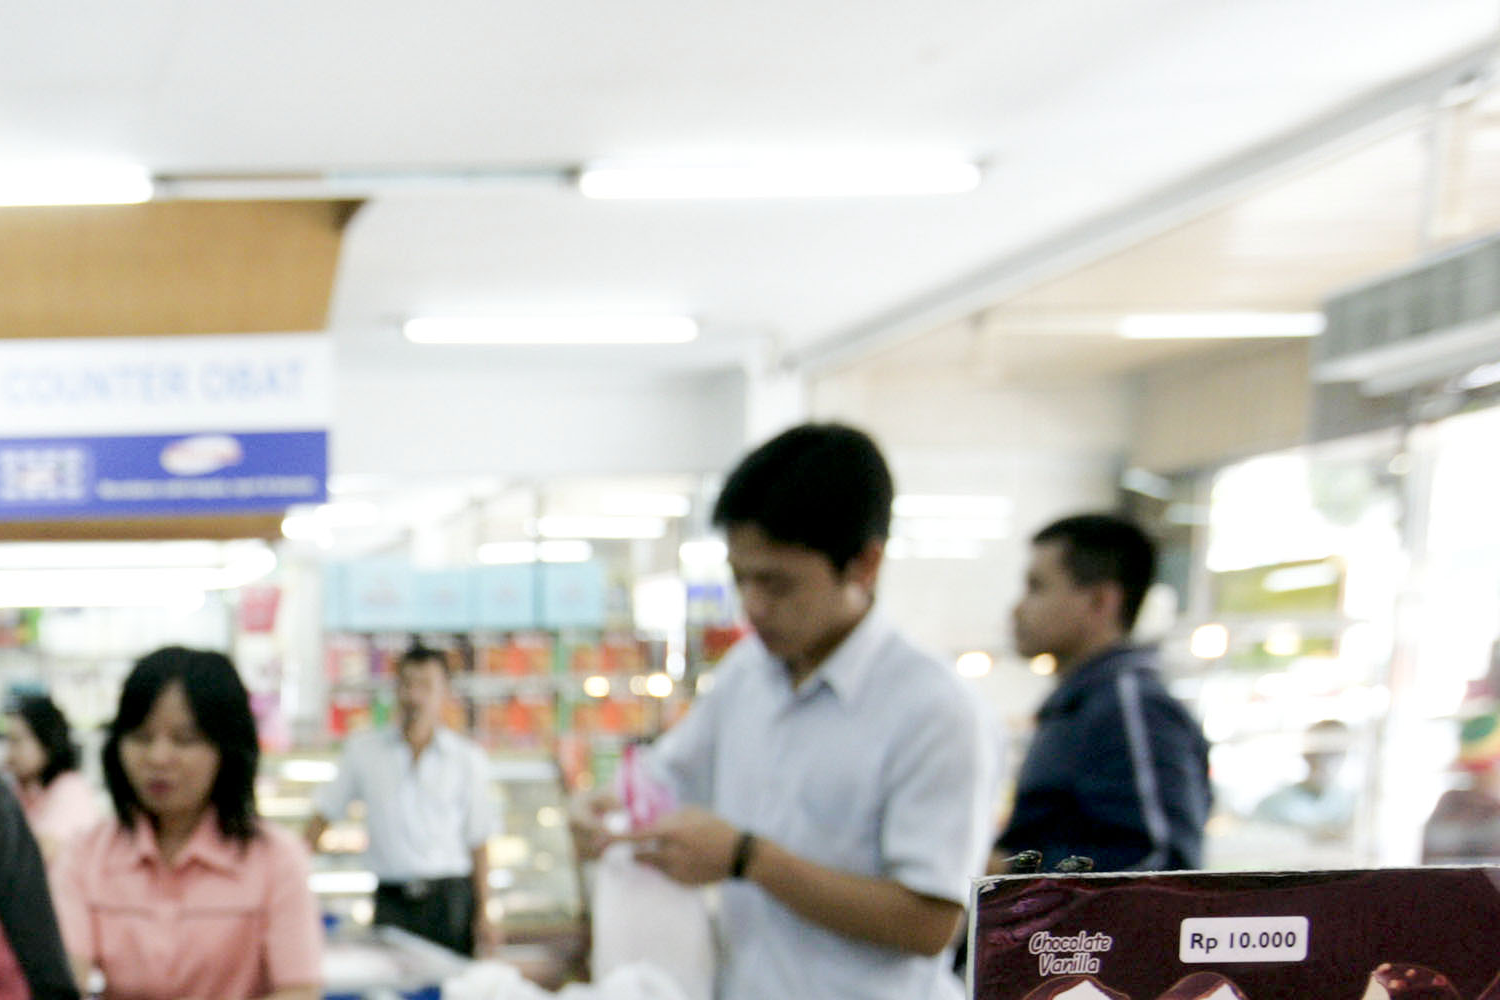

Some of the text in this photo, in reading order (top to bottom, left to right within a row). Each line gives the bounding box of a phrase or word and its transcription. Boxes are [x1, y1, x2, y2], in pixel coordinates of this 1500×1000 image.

[1029, 931, 1113, 954] Chocolate
[1190, 931, 1297, 955] Rp 10.000
[1038, 953, 1101, 976] Vanilla
